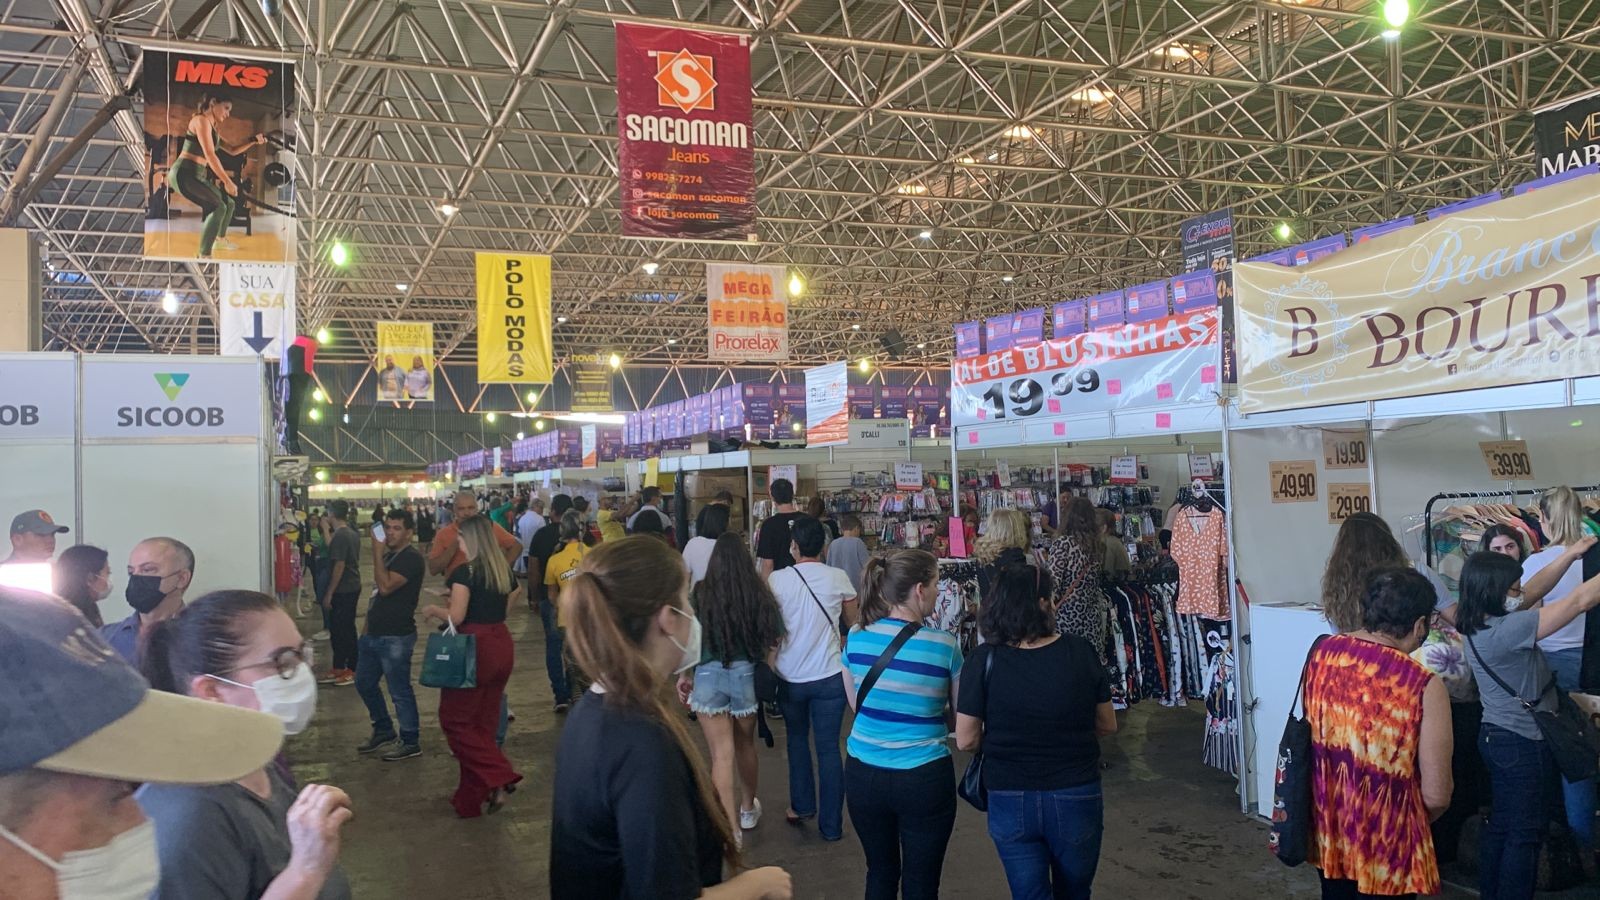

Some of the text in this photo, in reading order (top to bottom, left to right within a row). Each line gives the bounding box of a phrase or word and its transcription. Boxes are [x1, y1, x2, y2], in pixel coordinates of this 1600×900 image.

[175, 60, 268, 88] MKS
[671, 58, 701, 103] S
[626, 113, 747, 149] SACOMAN
[667, 147, 710, 164] Jeans
[698, 195, 747, 204] sacoman
[671, 210, 720, 220] sacoman
[240, 275, 274, 289] SUA
[723, 281, 771, 295] MEGA
[228, 292, 288, 308] CASA
[505, 259, 525, 377] POLO MODAS
[712, 307, 785, 324] FEIRÃO
[714, 332, 780, 354] Prorelax
[1284, 307, 1319, 358] B
[954, 359, 982, 381] AL
[987, 350, 1017, 377] DE
[1023, 313, 1209, 370] BLUSINHAS
[117, 406, 225, 427] SICOOB
[1334, 441, 1366, 467] 19,90
[1493, 452, 1531, 478] 39,90
[1280, 473, 1316, 500] 49,90
[1336, 496, 1370, 519] 2990
